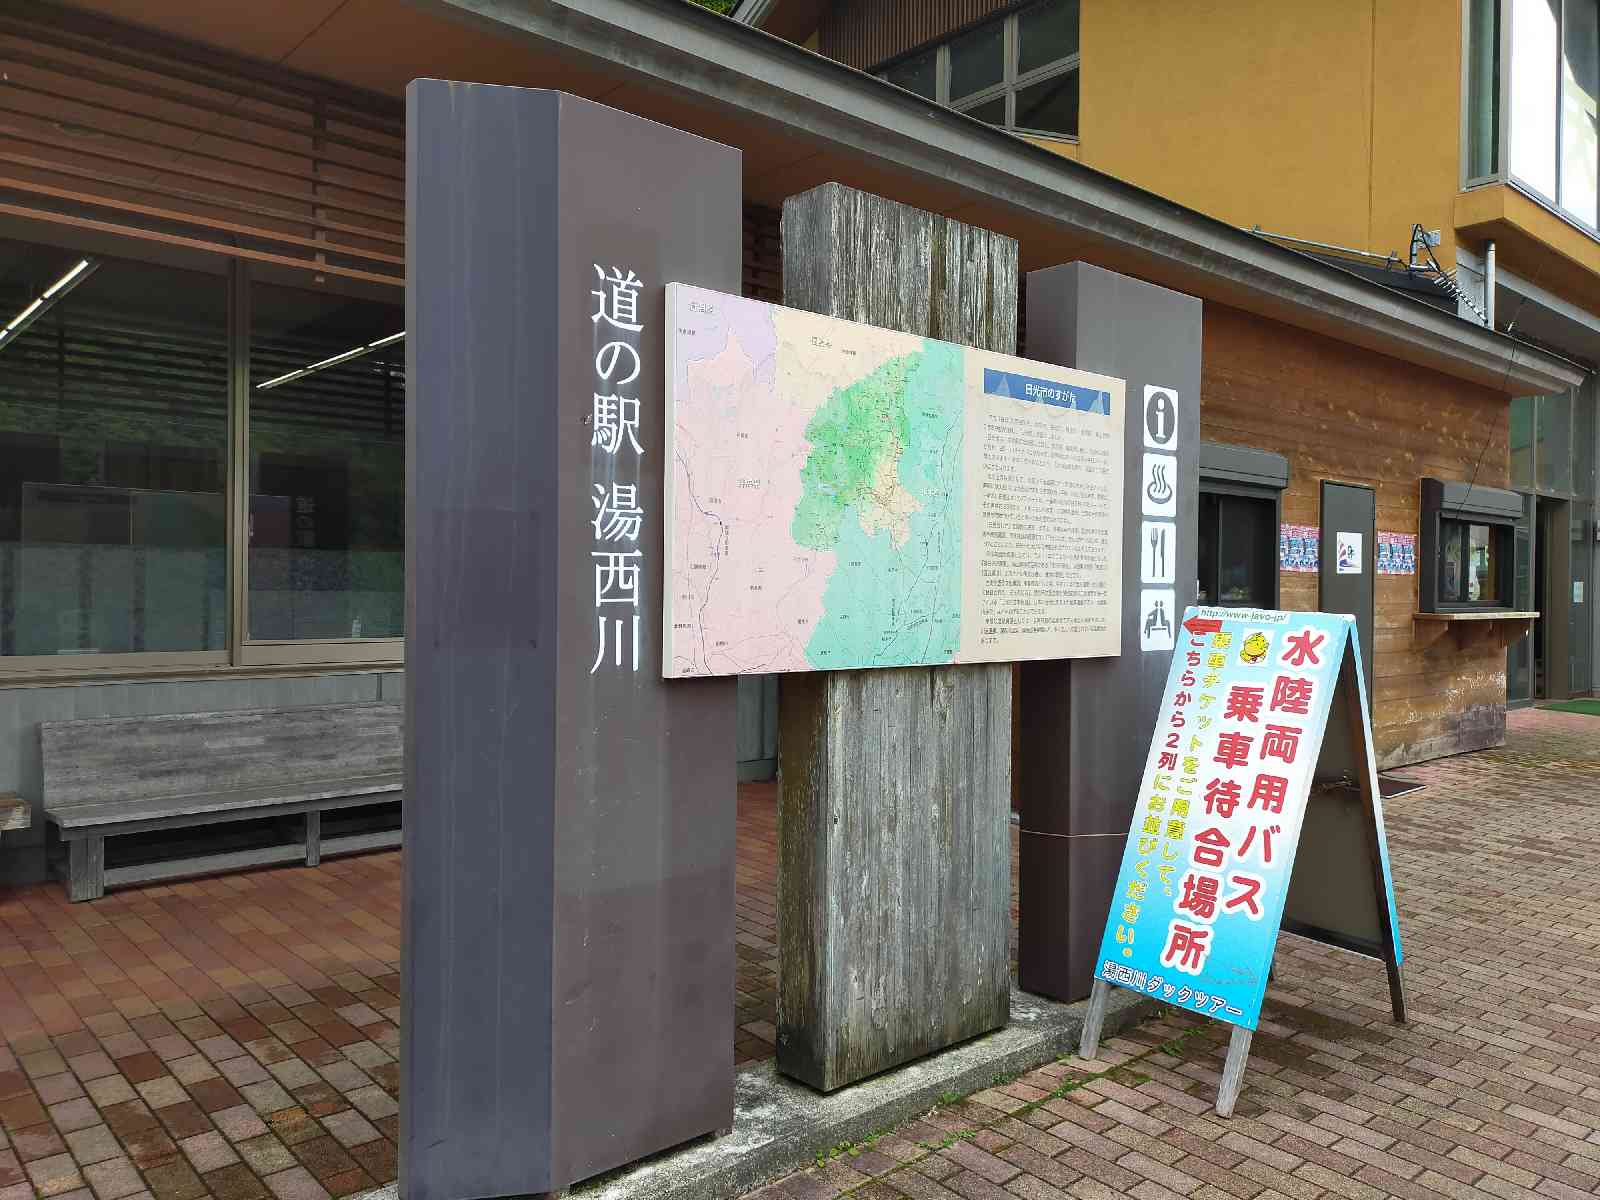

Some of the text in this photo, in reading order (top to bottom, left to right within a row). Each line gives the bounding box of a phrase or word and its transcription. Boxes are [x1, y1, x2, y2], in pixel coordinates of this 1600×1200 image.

[590, 263, 645, 674] 道の駅 湯西川
[1024, 383, 1077, 404] 日光市のすがた
[1164, 684, 1265, 970] 乗車待合場所
[1225, 629, 1326, 915] 水陸両用バス
[1101, 959, 1244, 1018] 湯西川ダックツアー
